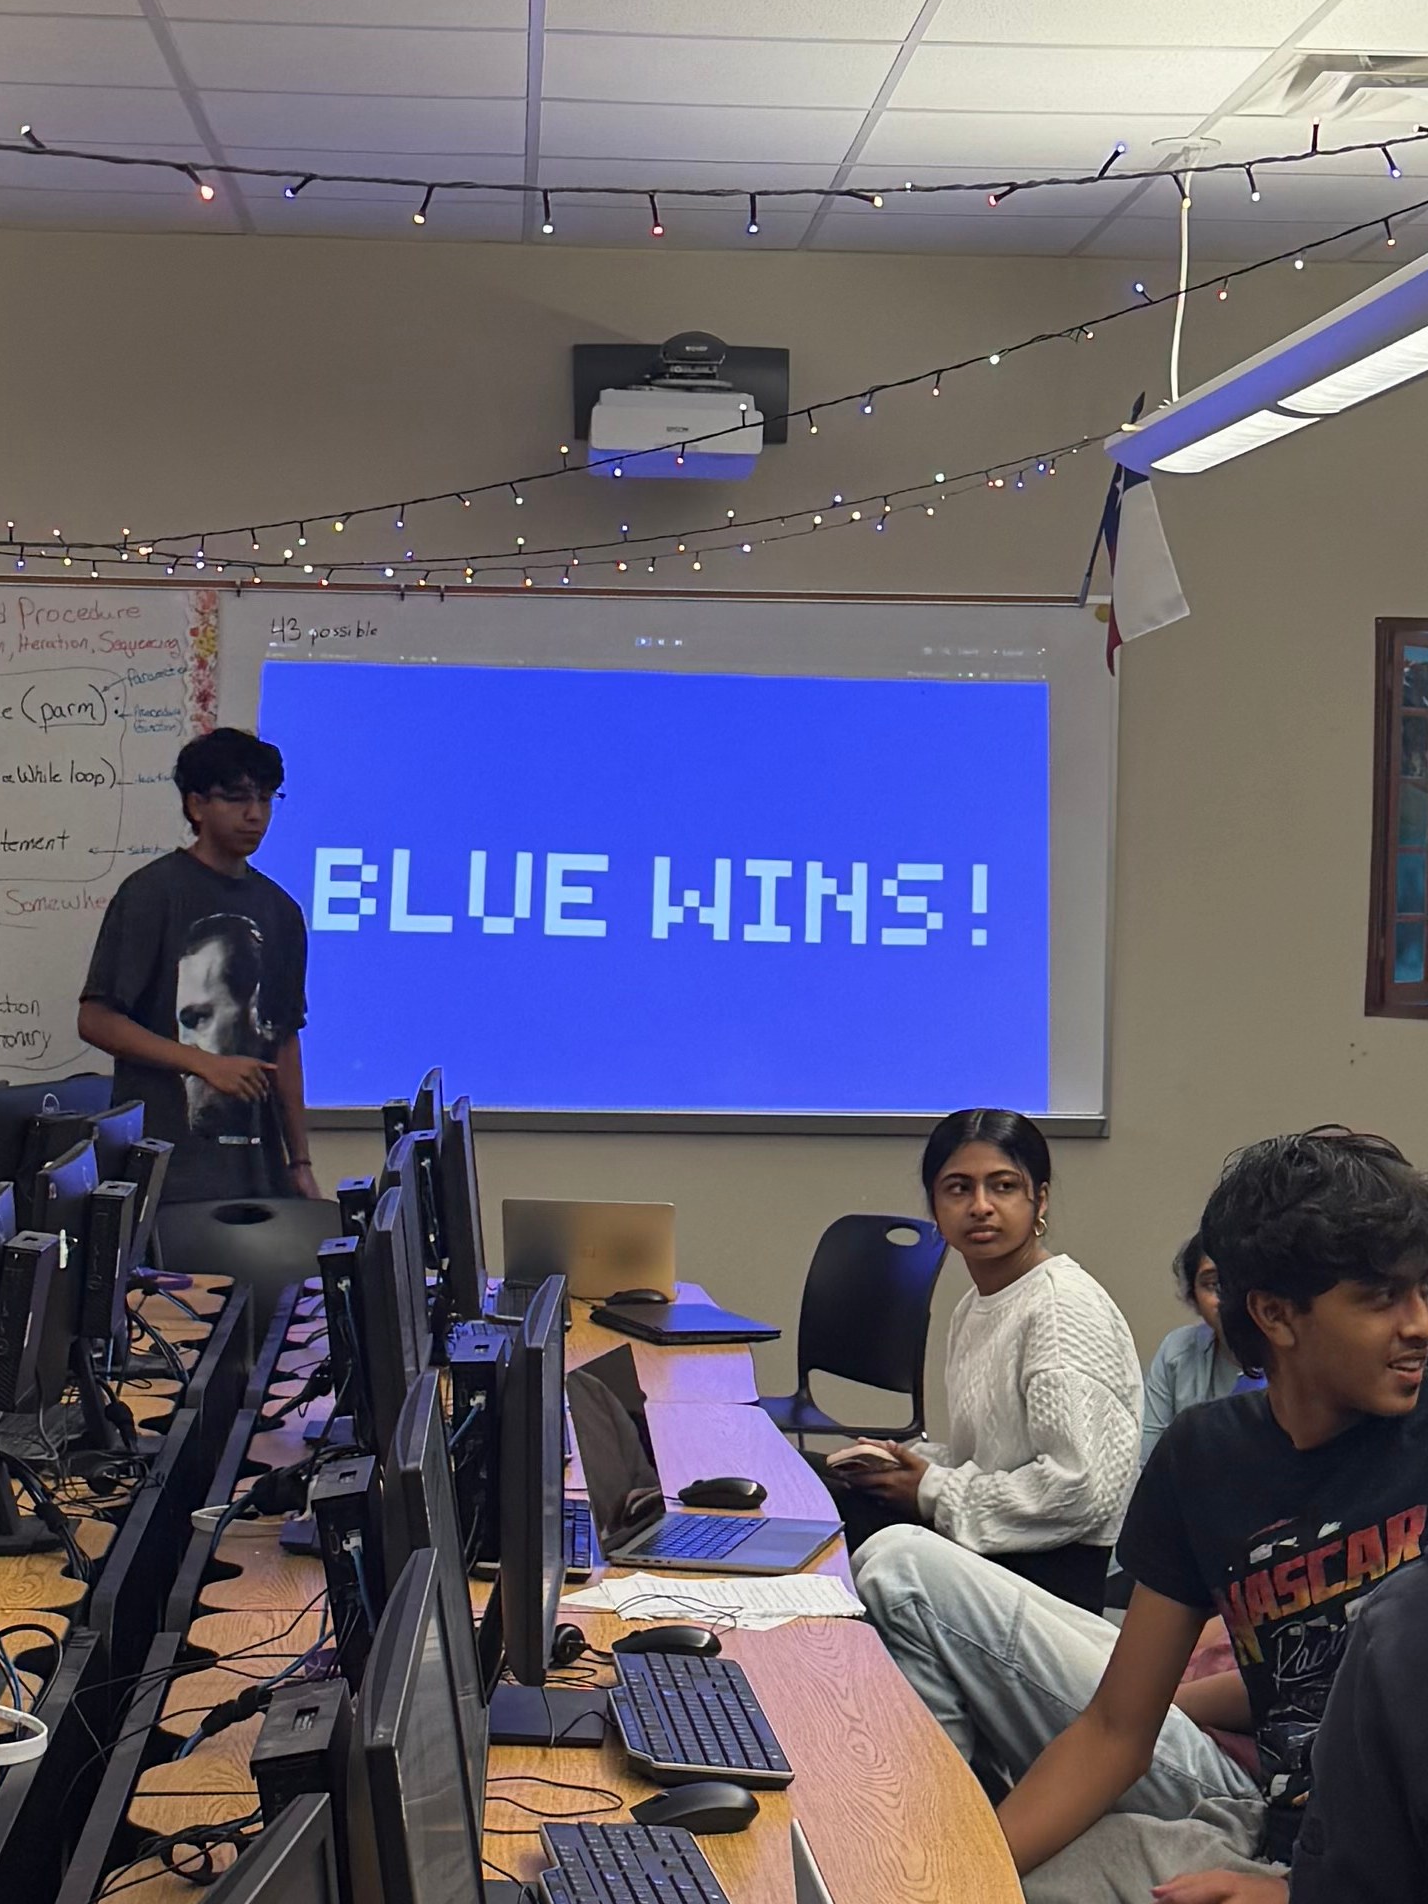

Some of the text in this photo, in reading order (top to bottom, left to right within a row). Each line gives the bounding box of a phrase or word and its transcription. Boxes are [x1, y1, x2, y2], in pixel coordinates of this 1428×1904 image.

[19, 596, 142, 631] Procedure
[271, 616, 378, 645] 43 possible
[311, 846, 989, 947] BLUE WINS!
[1216, 1504, 1428, 1667] NASCAR
